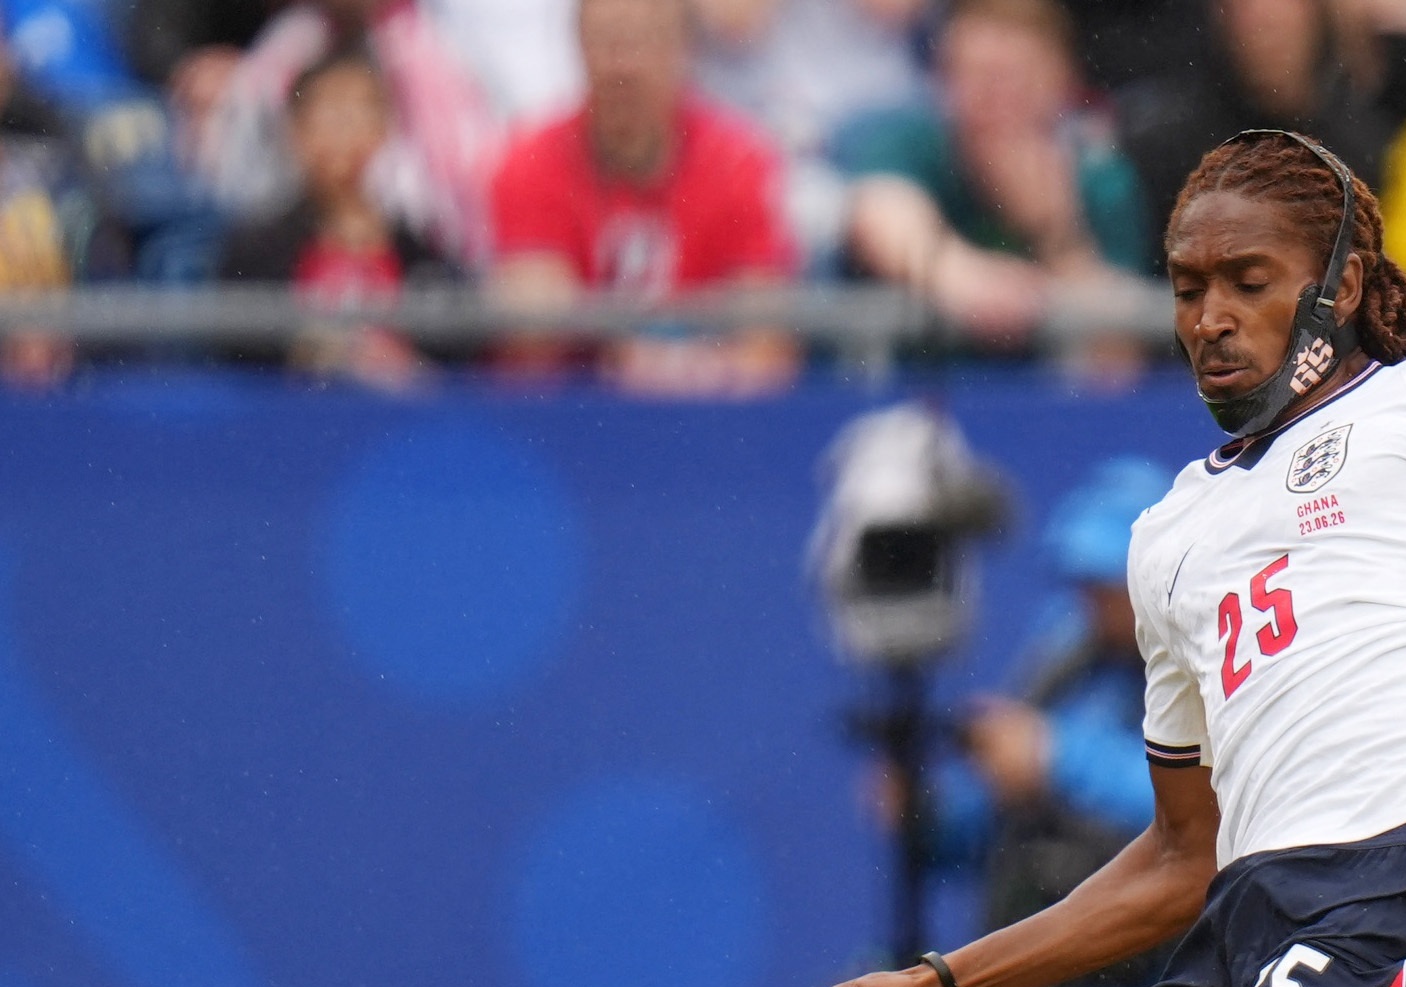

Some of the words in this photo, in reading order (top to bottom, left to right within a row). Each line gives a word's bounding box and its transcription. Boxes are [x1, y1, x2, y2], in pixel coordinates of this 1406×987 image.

[1297, 494, 1339, 518] GHANA
[1299, 511, 1345, 536] 23.06.26
[1218, 553, 1298, 701] 25
